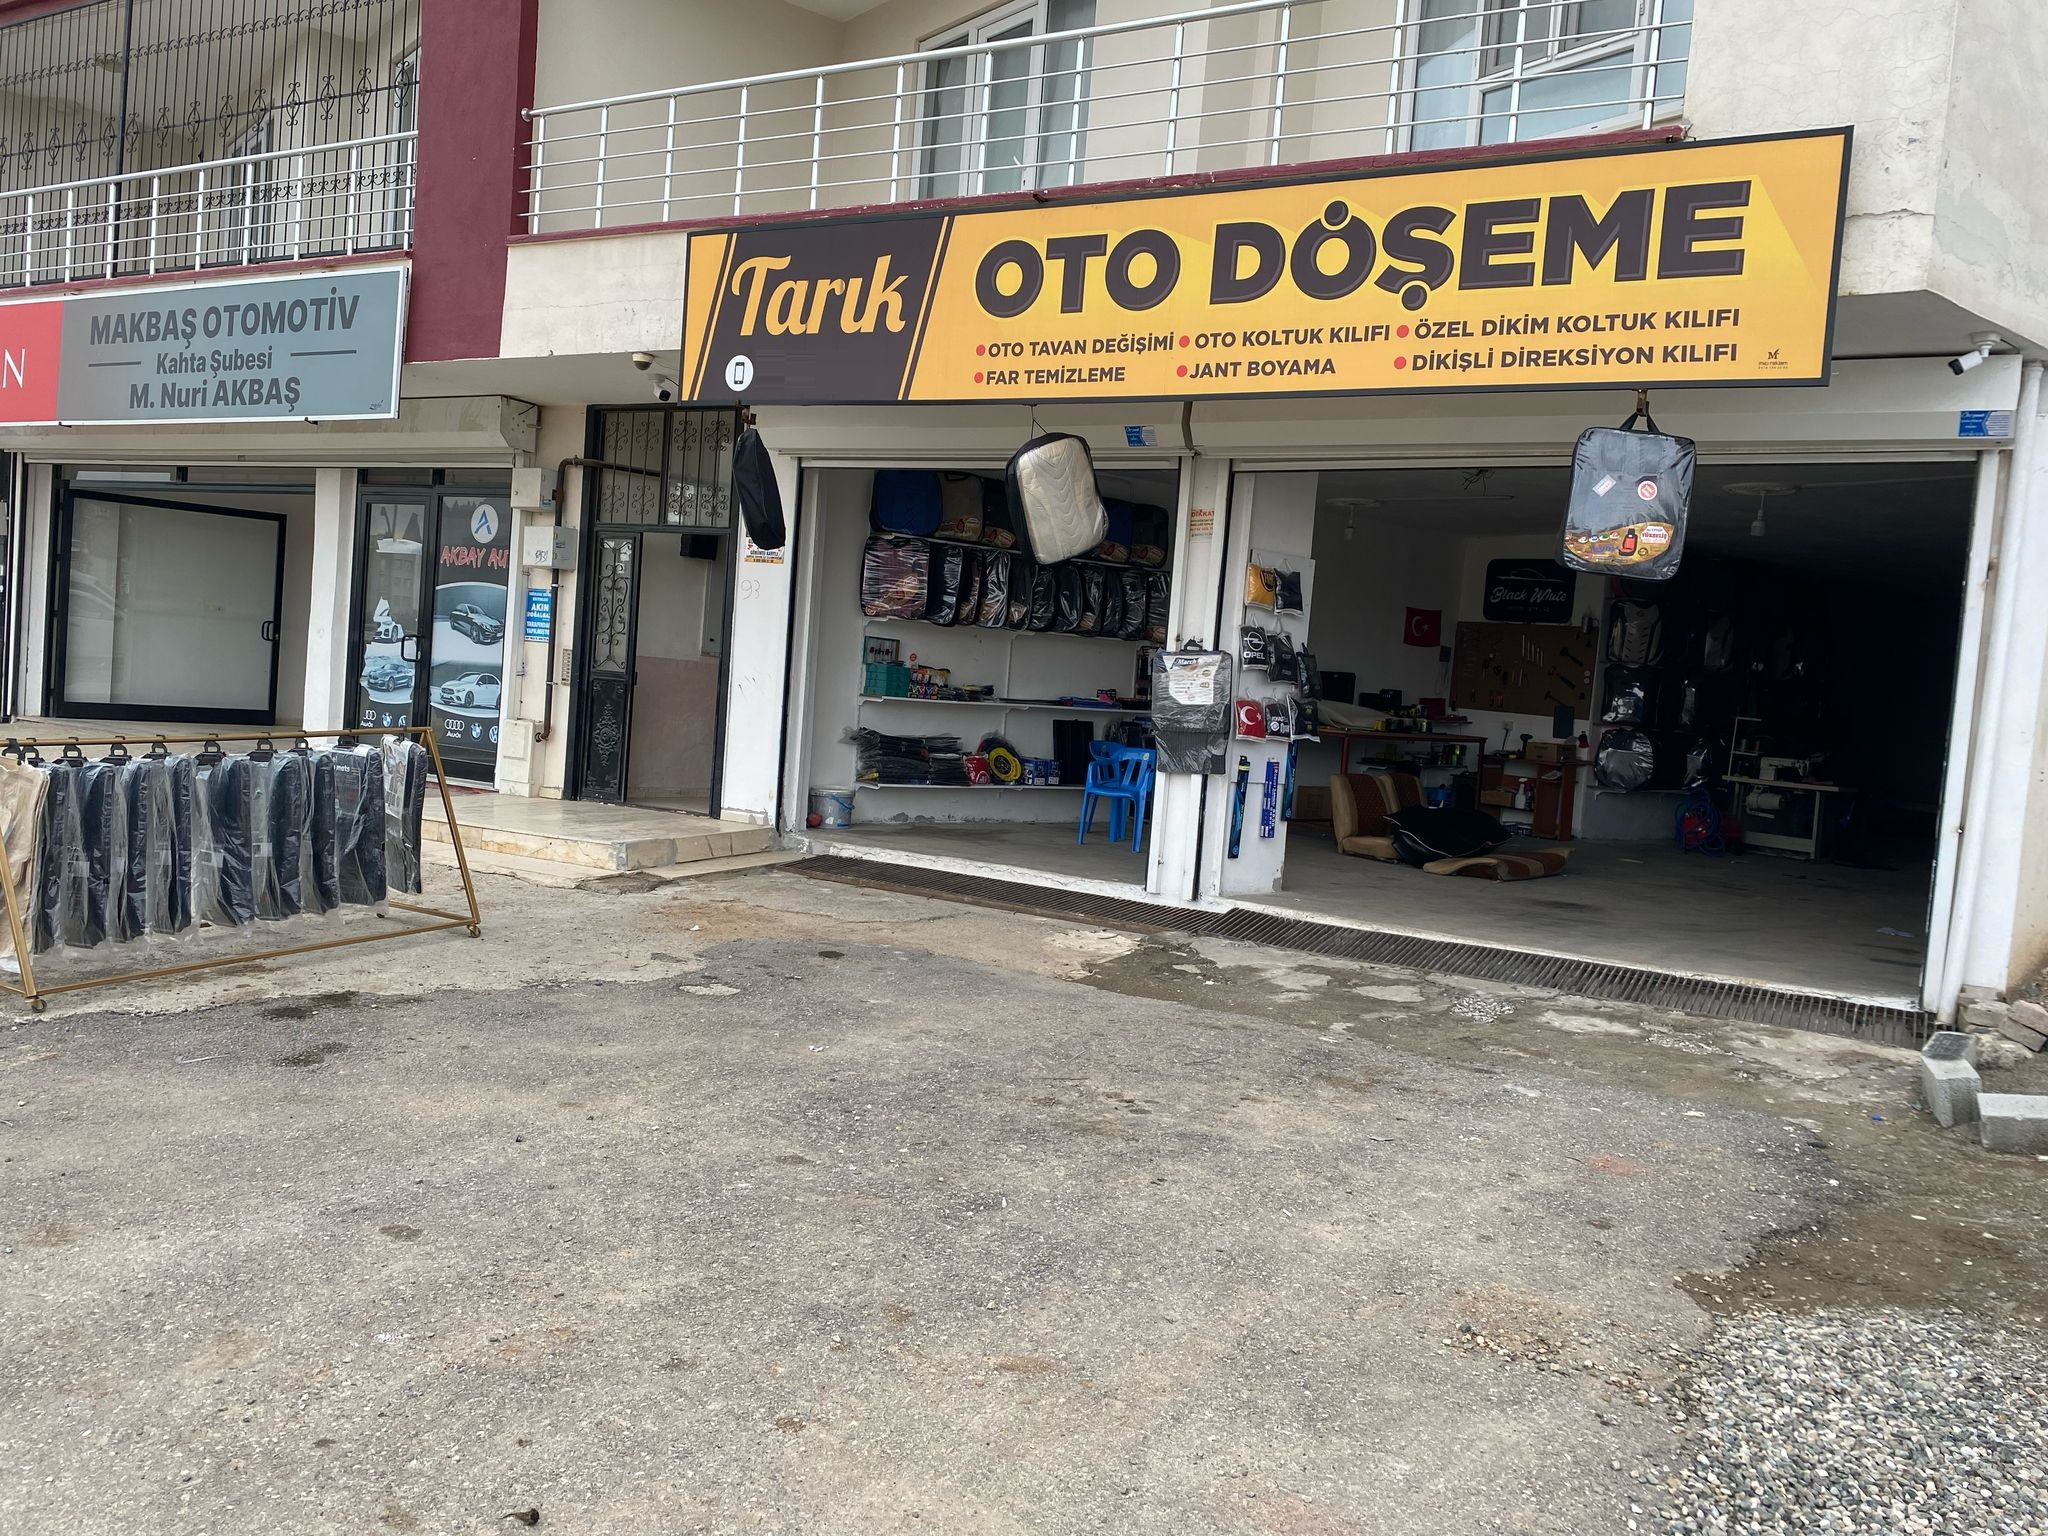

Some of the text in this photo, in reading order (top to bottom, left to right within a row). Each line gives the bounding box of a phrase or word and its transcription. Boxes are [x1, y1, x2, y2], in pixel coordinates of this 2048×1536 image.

[975, 179, 1752, 319] OTO DÖŞEME
[731, 254, 909, 336] Tarık
[89, 287, 361, 349] MAKBAŞ OTOMOTİV
[1414, 308, 1740, 340] ÖZEL DİKİM KOLTUK KILIFI
[988, 331, 1174, 358] OTO TAVAN DEĞİŞİMİ
[1194, 325, 1391, 349] OTO KOLTUK KILIFI
[156, 346, 274, 378] Kahta Şubesi
[1189, 358, 1336, 380] JANT BOYAMA
[1412, 343, 1737, 373] DİKİŞLİ DİREKSİYON KILIFI
[986, 364, 1126, 386] FAR TEMİZLEME
[129, 376, 301, 413] M. Nuri AKBAŞ
[440, 545, 486, 569] AKBAY
[741, 579, 761, 600] 93
[1490, 586, 1567, 603] Black White
[531, 603, 549, 612] AKIN
[1243, 651, 1265, 660] OPEL
